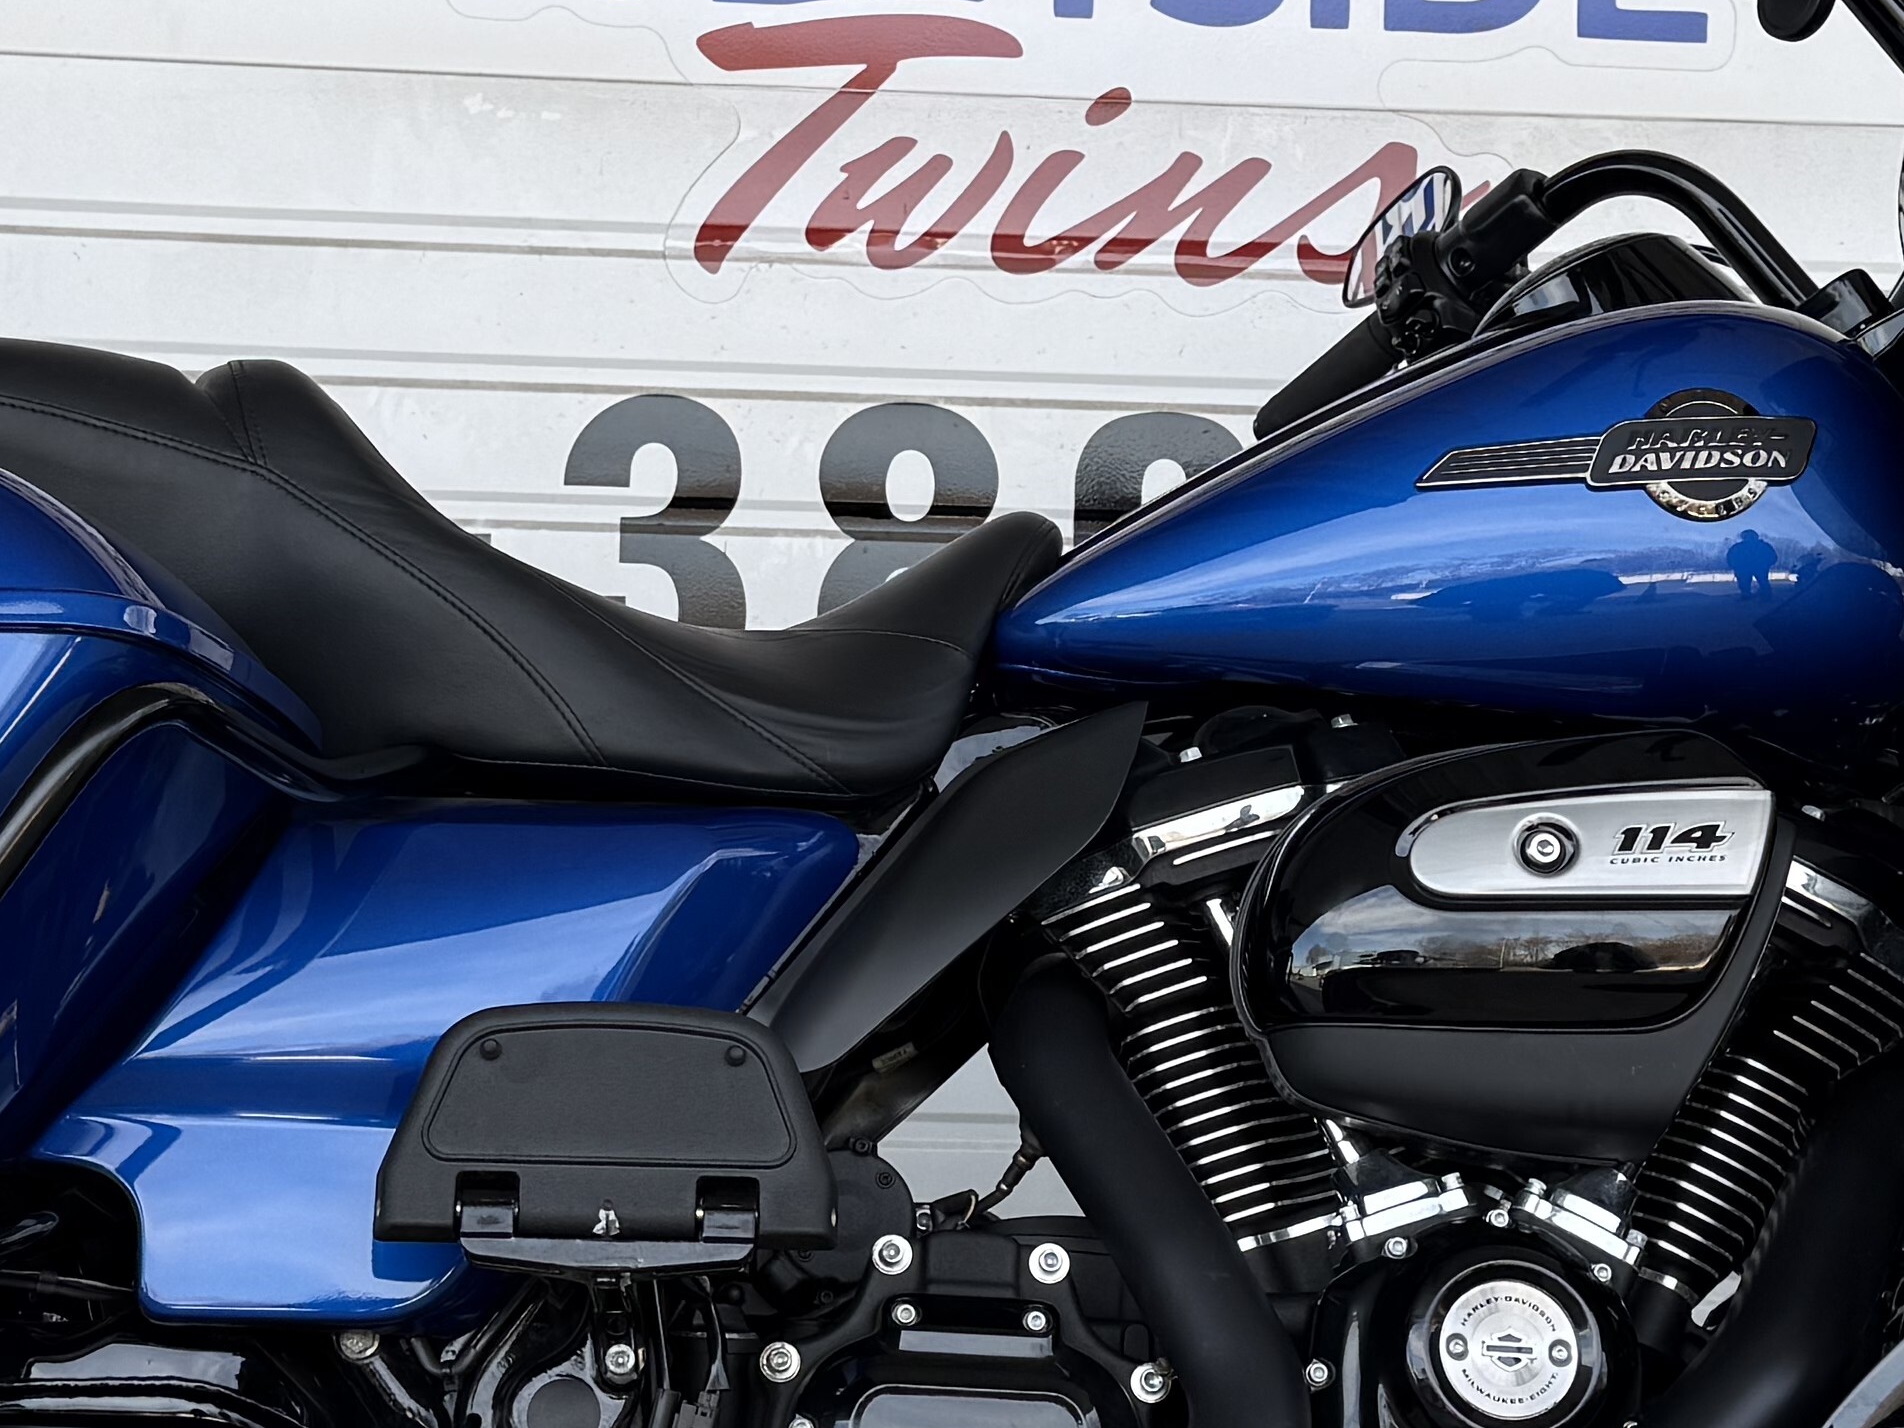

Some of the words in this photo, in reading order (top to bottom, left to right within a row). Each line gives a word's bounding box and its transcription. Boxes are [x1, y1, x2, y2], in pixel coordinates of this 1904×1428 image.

[695, 13, 1492, 287] Twins
[1608, 448, 1792, 474] DAVIDSON
[1612, 821, 1736, 855] 114
[1609, 856, 1660, 865] CUBIC
[1668, 854, 1727, 863] INCHES
